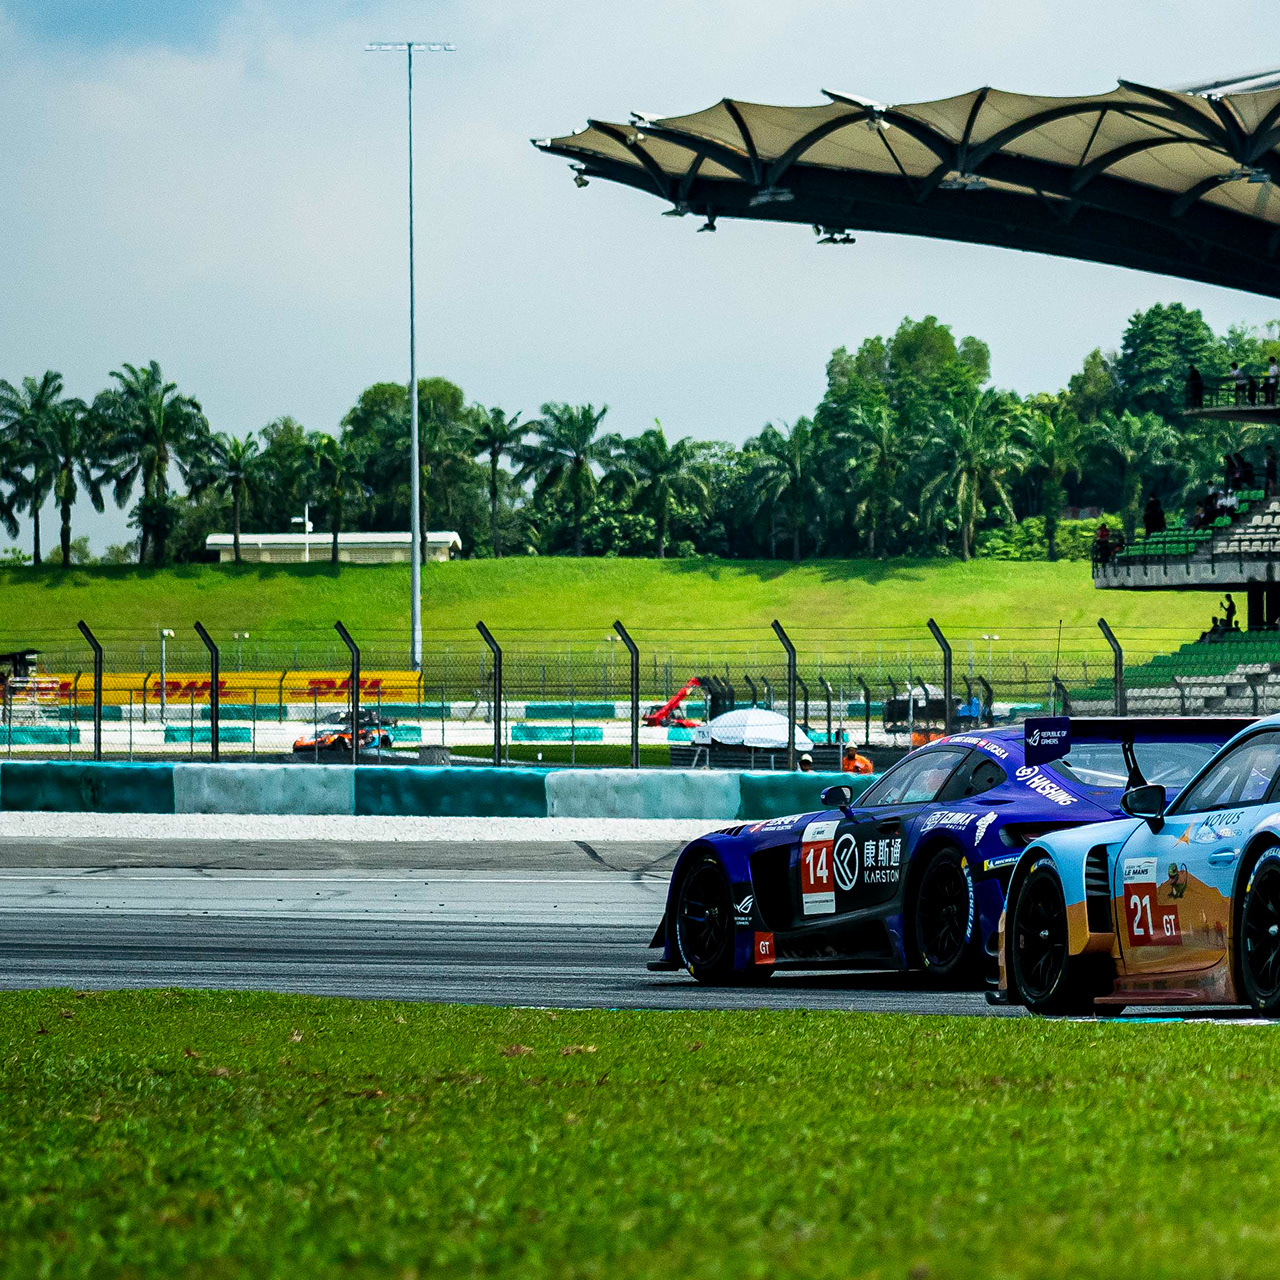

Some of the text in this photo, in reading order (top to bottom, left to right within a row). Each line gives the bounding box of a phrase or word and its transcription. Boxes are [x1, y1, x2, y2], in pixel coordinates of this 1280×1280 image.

[1026, 774, 1078, 806] HASHING
[1201, 811, 1245, 828] NOVUS
[805, 847, 829, 885] 14
[864, 838, 902, 868] 康斯通
[864, 869, 900, 883] KARSTON
[966, 876, 975, 938] MICHELIN
[1130, 894, 1154, 936] 21
[1163, 914, 1176, 937] GT
[759, 941, 770, 955] GT
